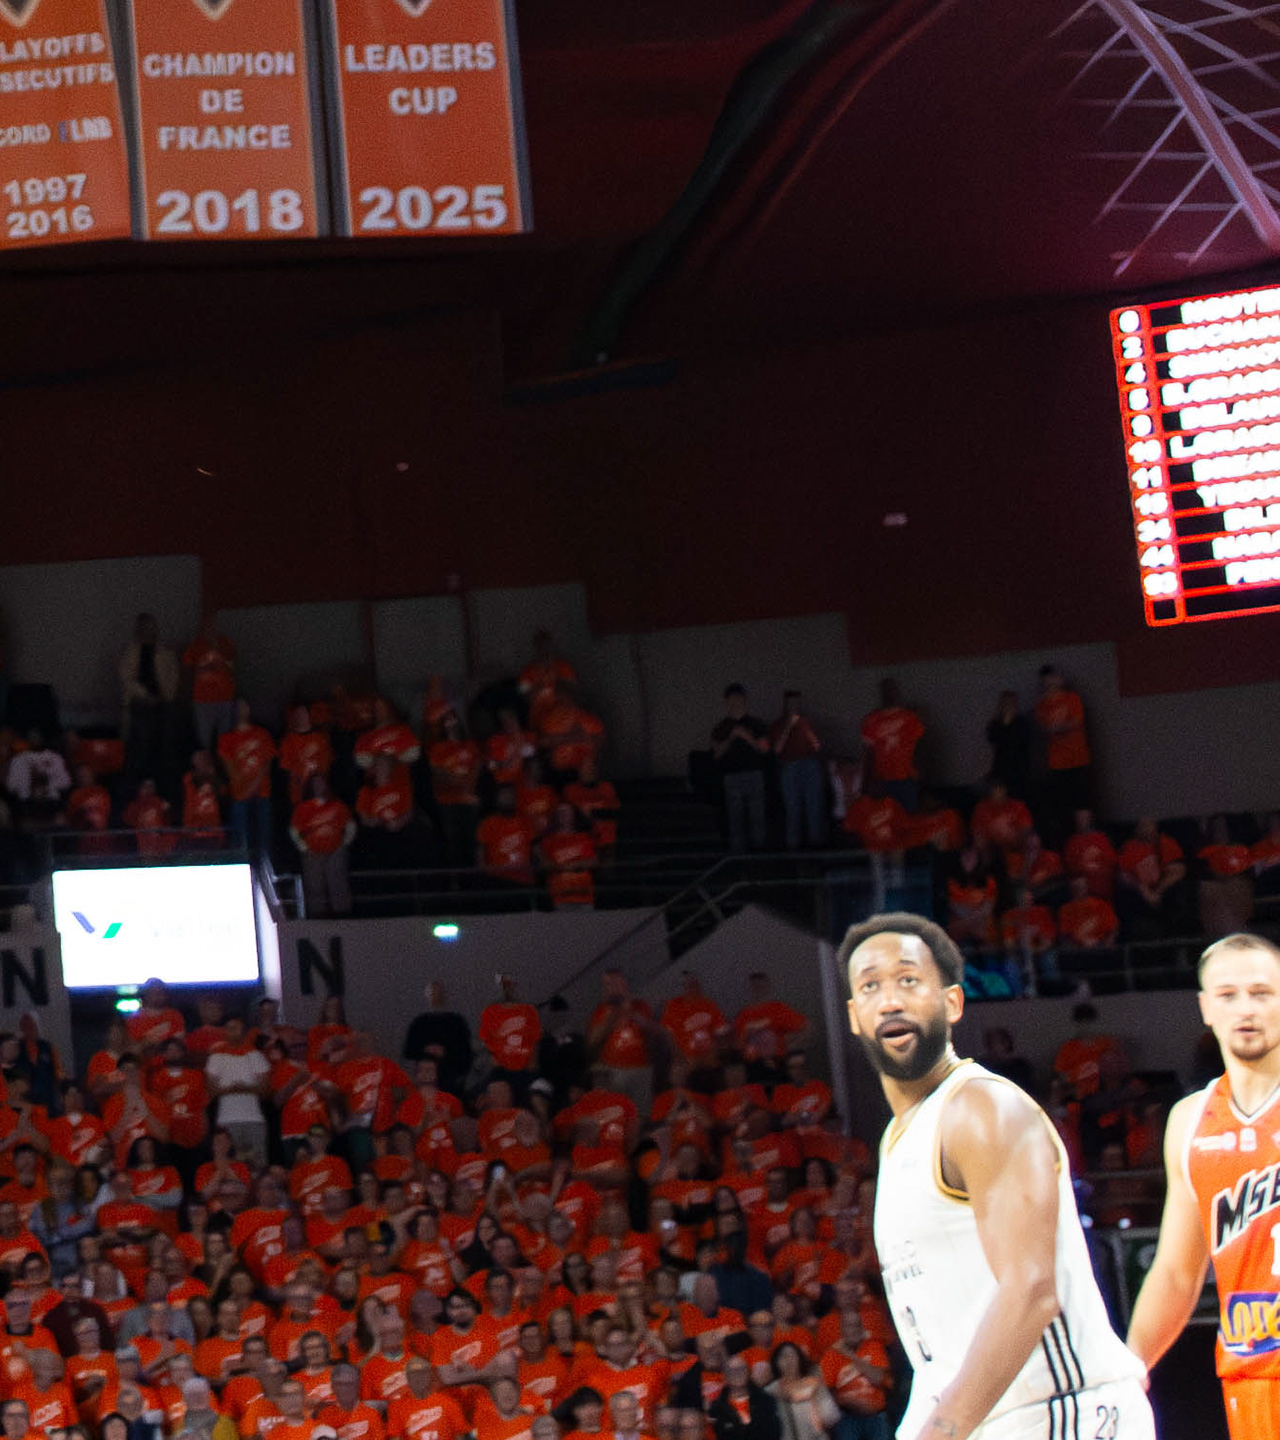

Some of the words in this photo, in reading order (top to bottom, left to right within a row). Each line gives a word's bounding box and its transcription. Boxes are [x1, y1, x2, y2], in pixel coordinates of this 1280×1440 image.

[143, 52, 295, 78] CHAMPION
[345, 42, 496, 73] LEADERS
[199, 89, 244, 113] DE
[388, 87, 458, 116] CUP
[157, 124, 291, 151] FRANCE
[3, 173, 87, 207] 1997
[5, 204, 94, 239] 2016
[155, 188, 305, 234] 2018
[359, 185, 508, 232] 2025
